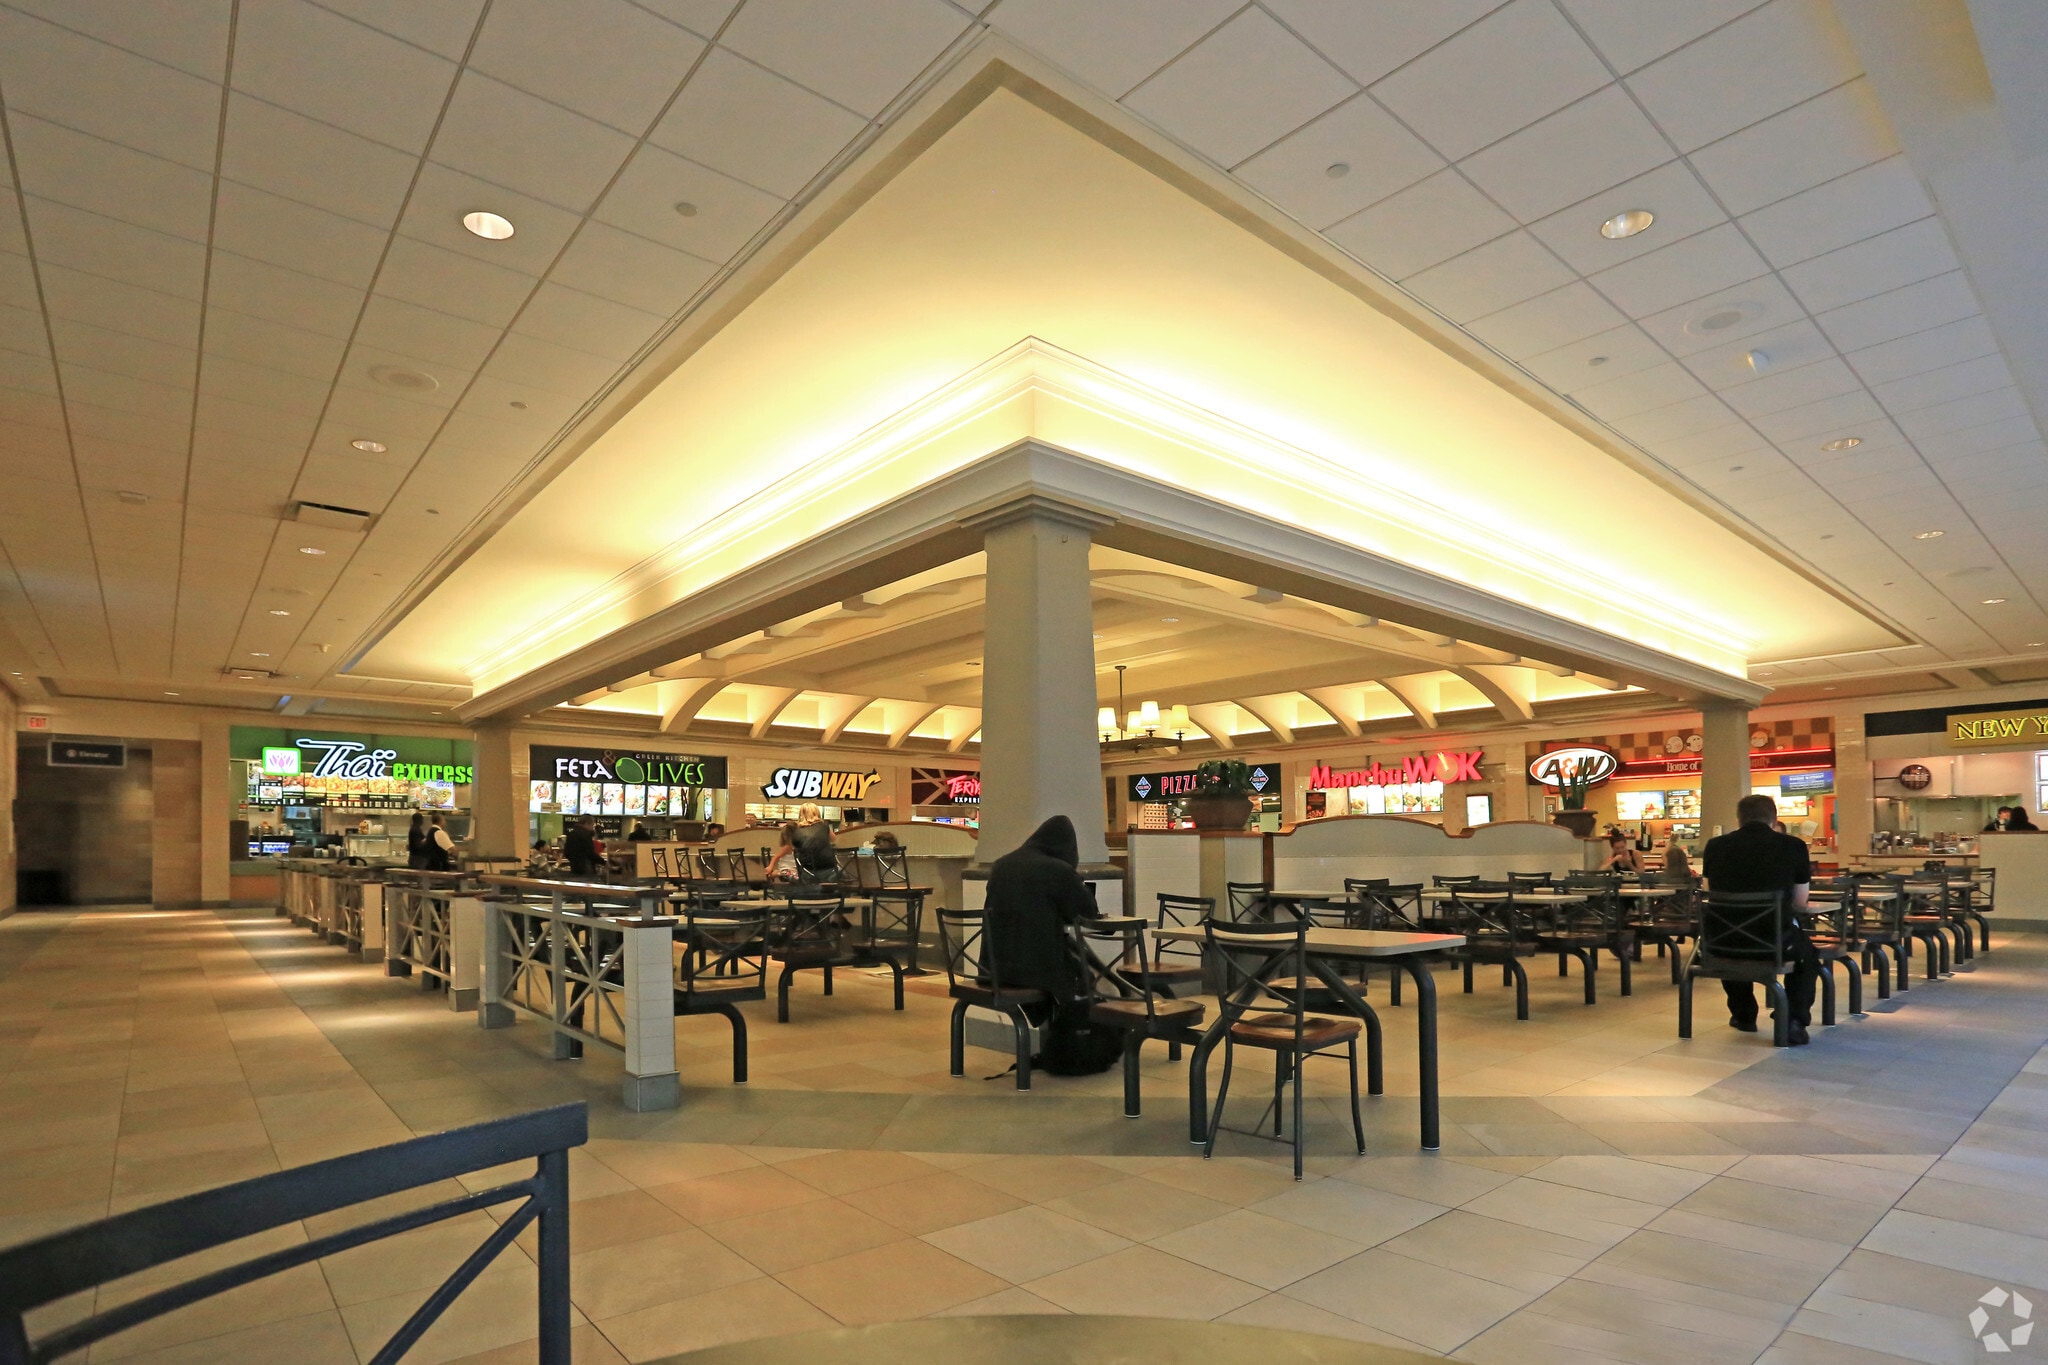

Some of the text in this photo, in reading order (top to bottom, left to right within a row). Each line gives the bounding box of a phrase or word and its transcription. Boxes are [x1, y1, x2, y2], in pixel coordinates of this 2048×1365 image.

[30, 717, 47, 728] EXIT
[1953, 717, 2028, 740] NEW
[556, 758, 613, 779] FETA
[1309, 751, 1484, 790] Manchu WOK
[1541, 755, 1606, 779] A&W
[1666, 762, 1689, 772] Home
[1689, 761, 1698, 770] of
[764, 768, 882, 800] SUBWAY
